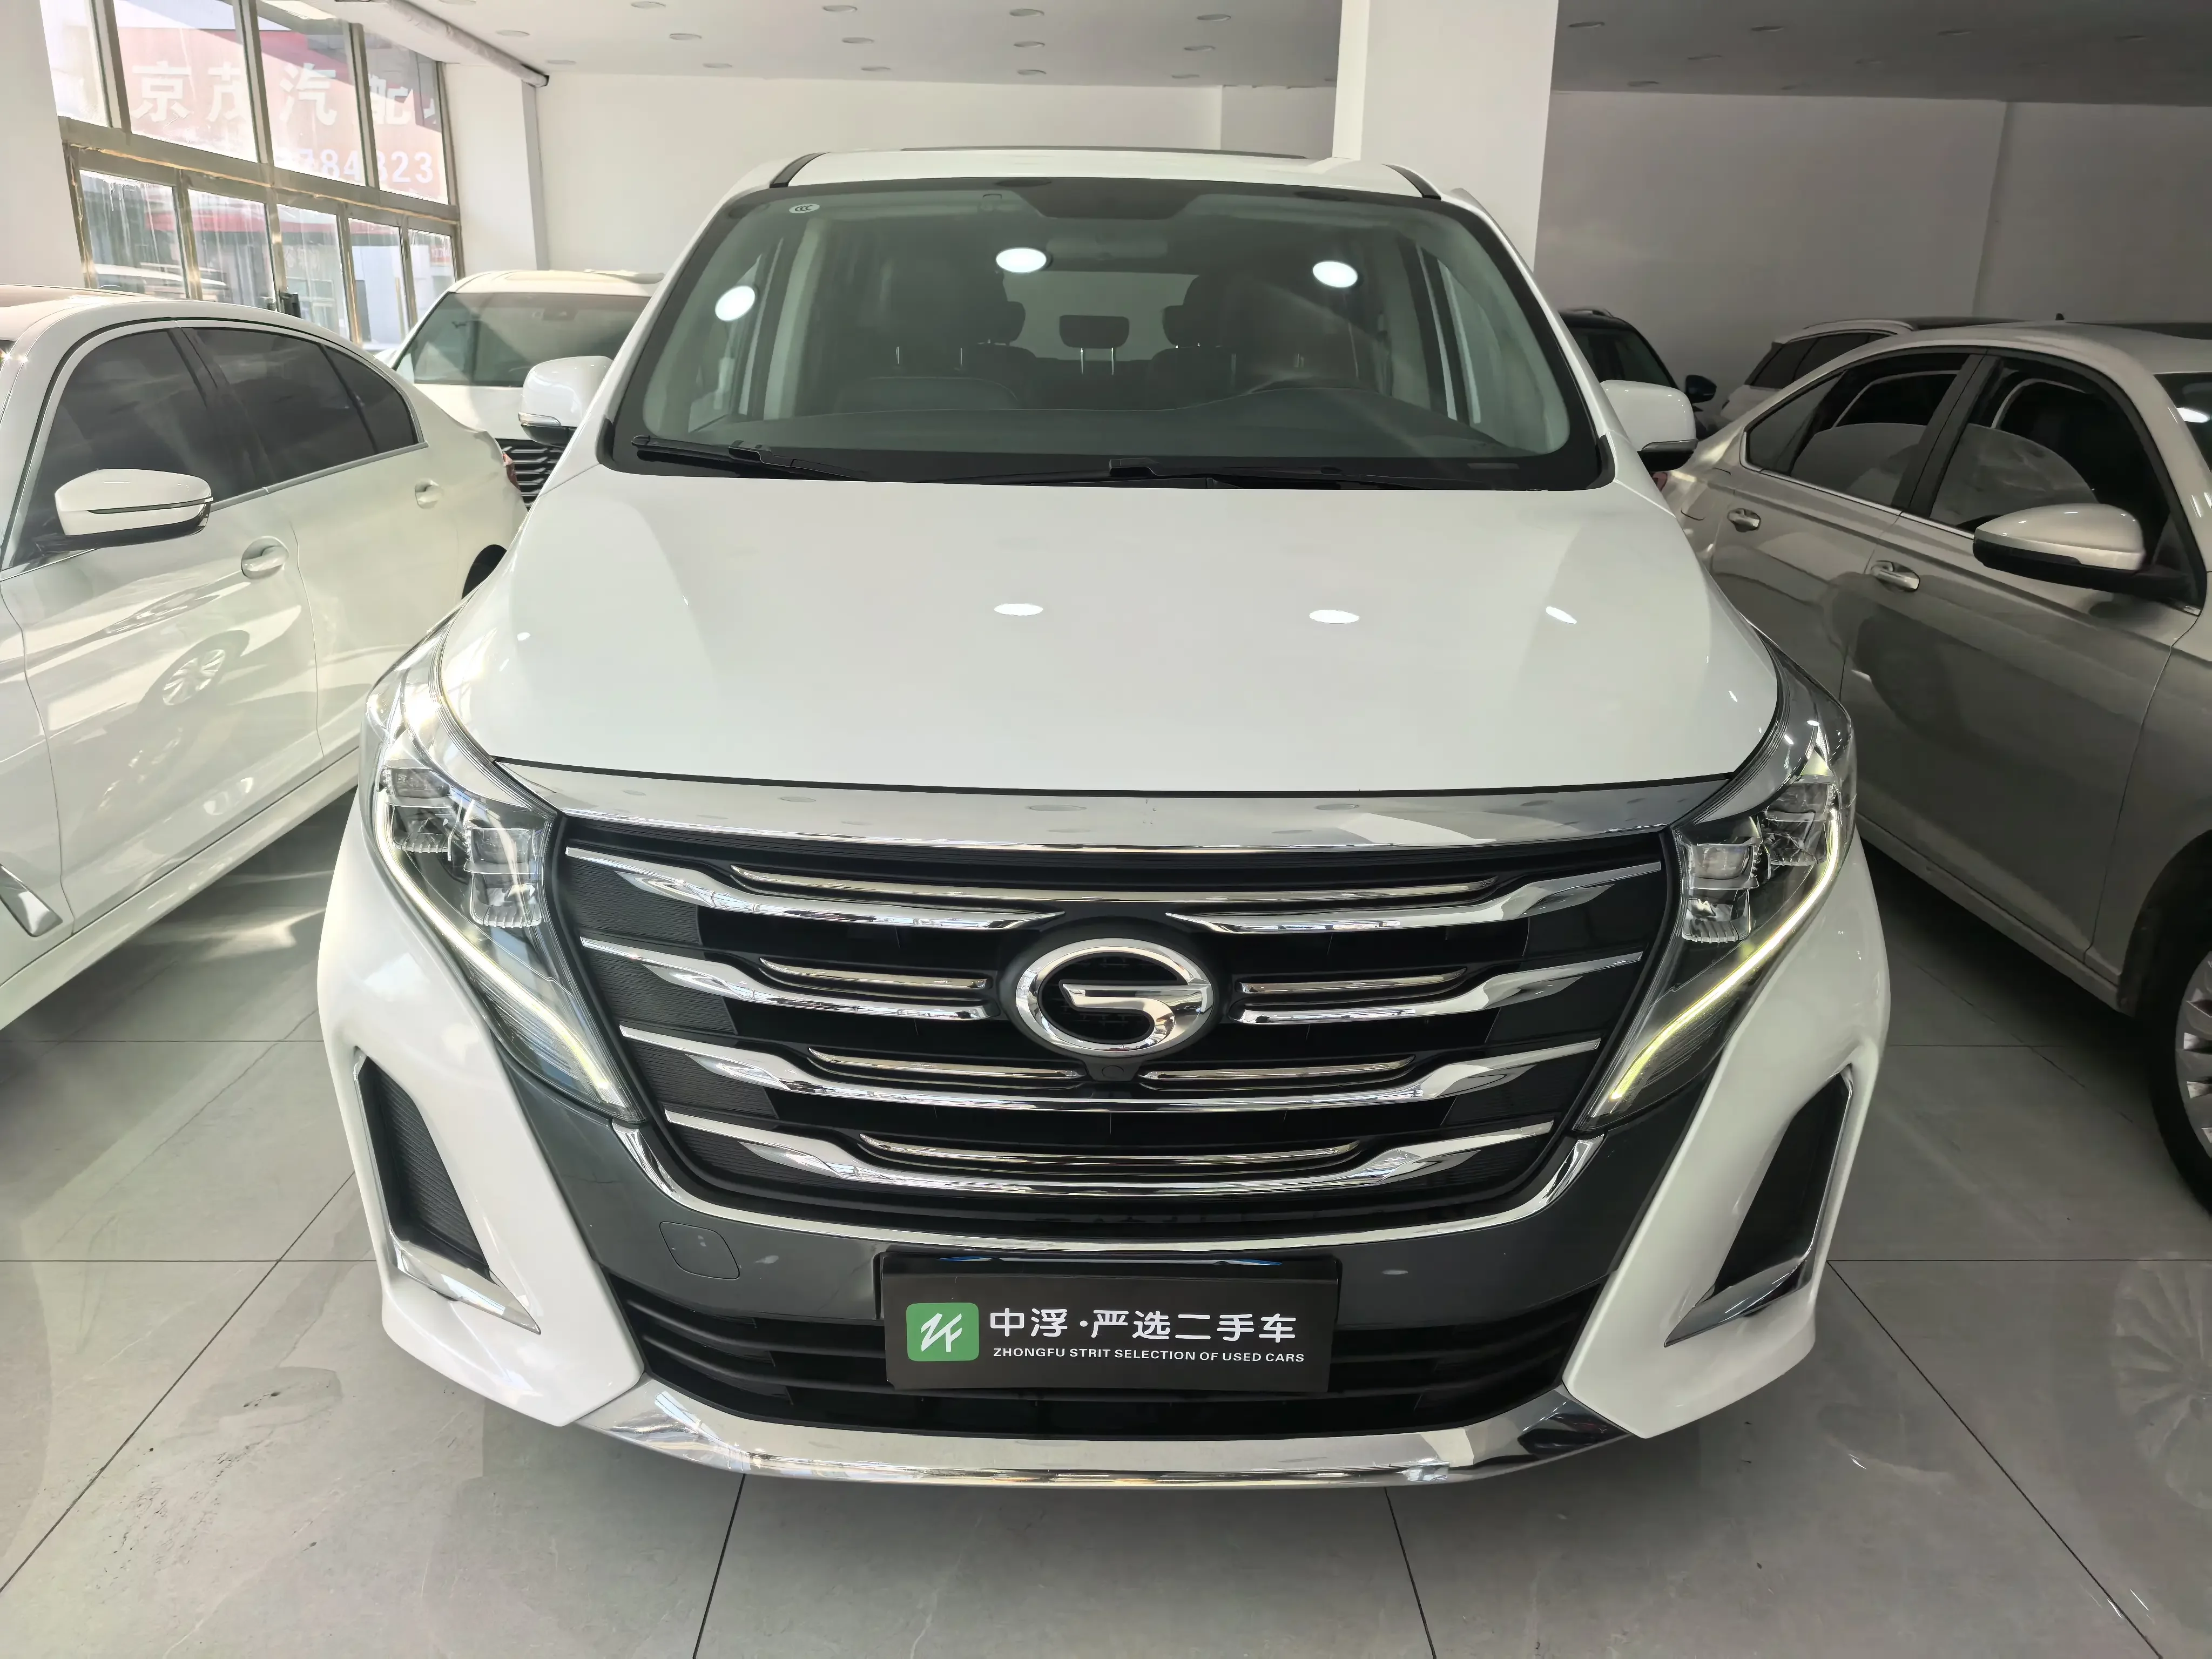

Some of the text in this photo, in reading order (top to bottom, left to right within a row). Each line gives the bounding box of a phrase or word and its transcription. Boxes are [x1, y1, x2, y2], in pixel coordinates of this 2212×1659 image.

[130, 60, 435, 126] 京茂汽配
[990, 1307, 1296, 1343] 中浮·严选二手车
[993, 1348, 1304, 1362] ZHONGFU STRIT SELECTION OF USED CARS
